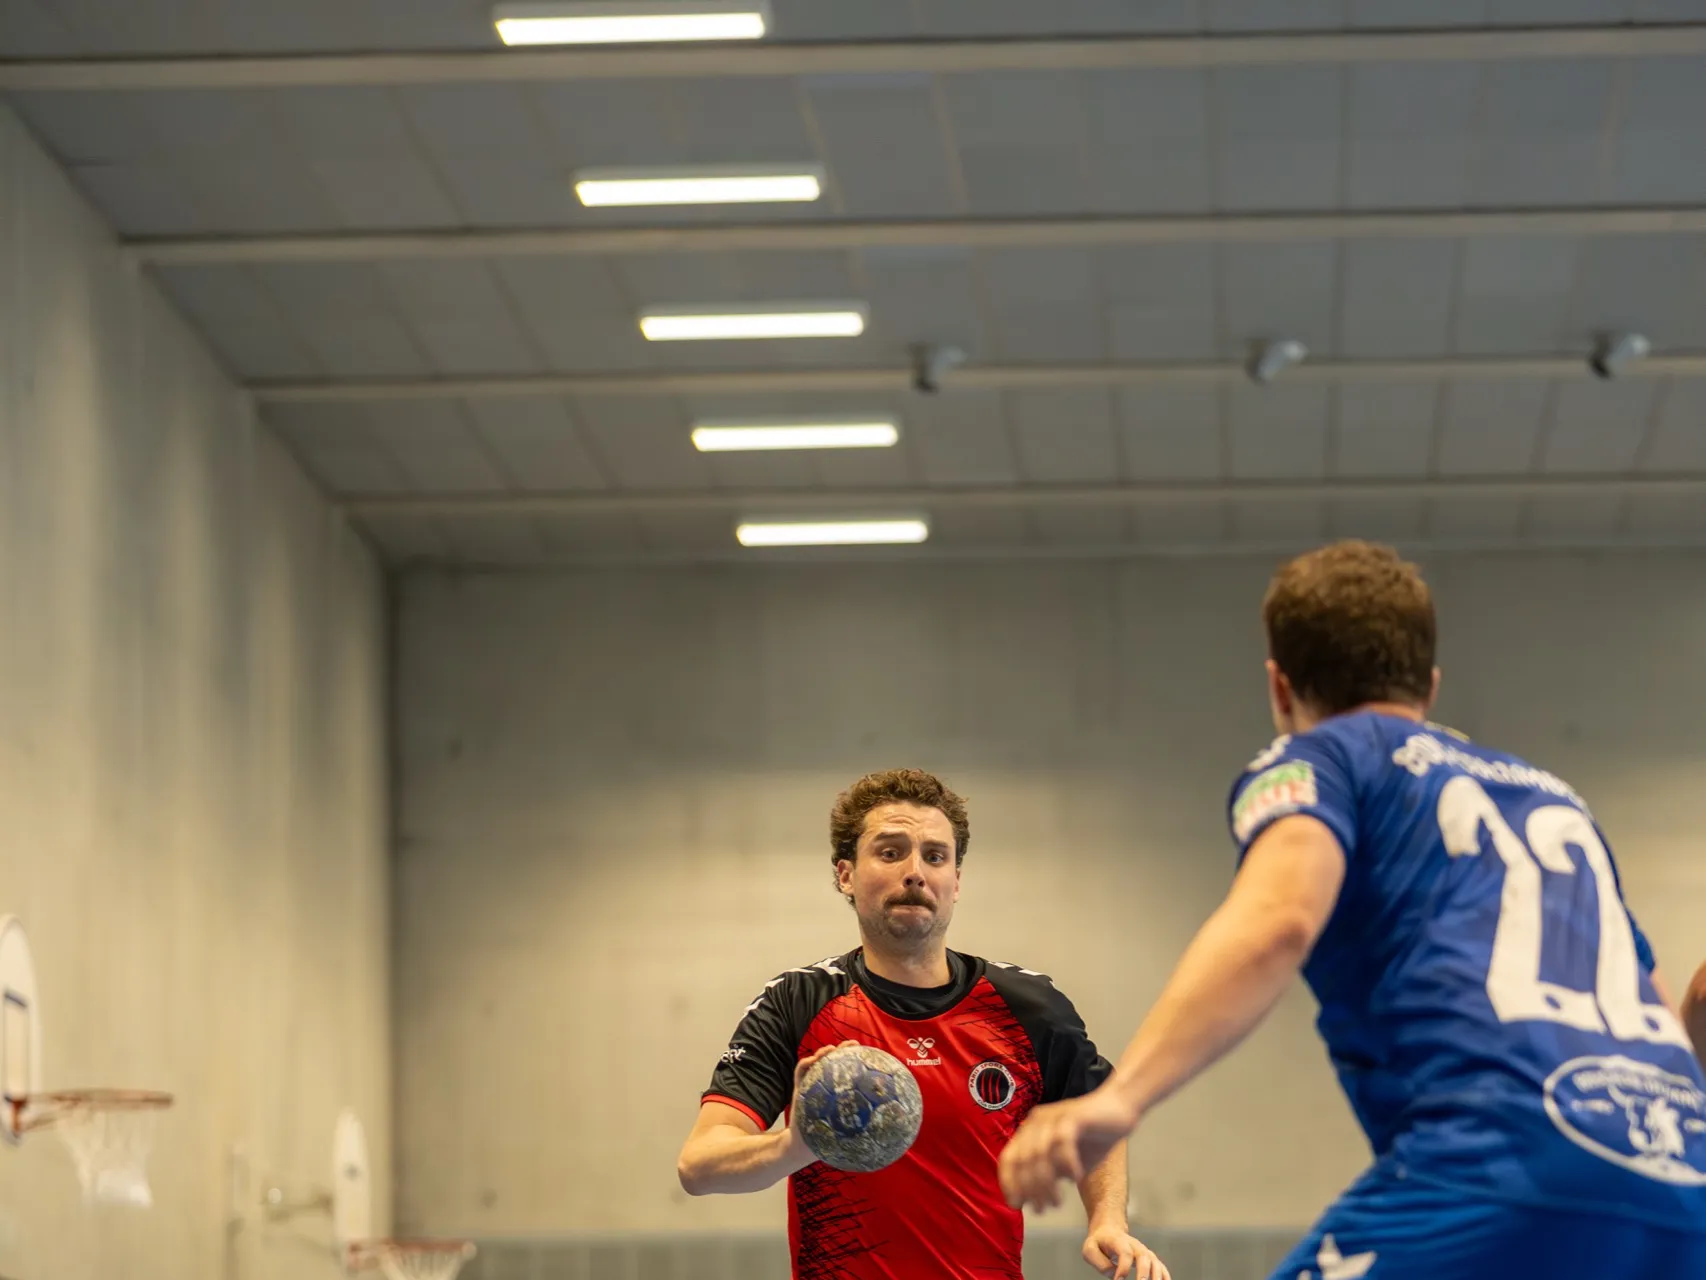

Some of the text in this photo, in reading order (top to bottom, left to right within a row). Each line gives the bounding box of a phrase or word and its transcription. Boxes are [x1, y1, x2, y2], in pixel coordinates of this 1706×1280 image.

[1437, 775, 1695, 1054] 22
[906, 1056, 941, 1067] hummel
[969, 1068, 980, 1089] PARIS
